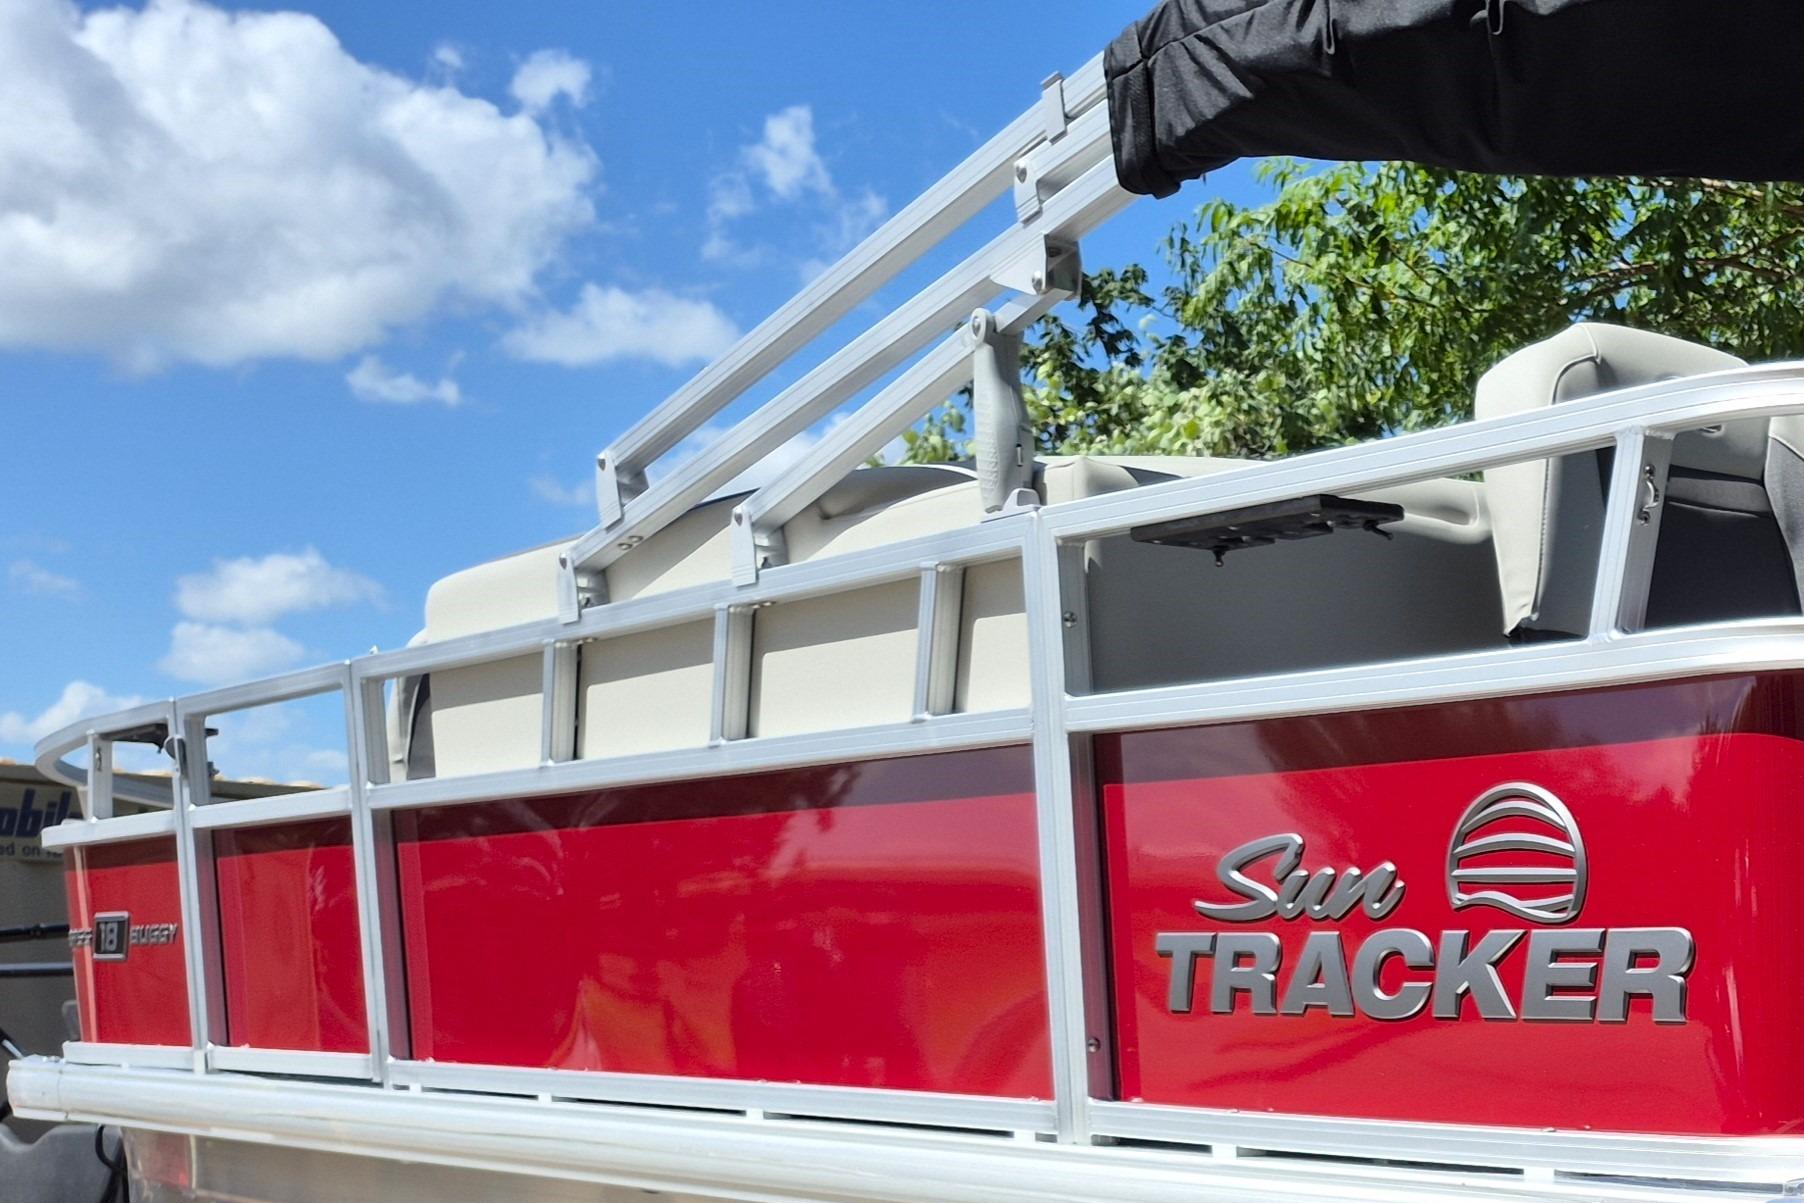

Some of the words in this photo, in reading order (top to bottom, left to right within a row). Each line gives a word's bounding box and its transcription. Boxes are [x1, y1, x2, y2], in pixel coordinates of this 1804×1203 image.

[1193, 832, 1407, 921] Sun
[100, 922, 119, 951] 18
[1154, 926, 1696, 1024] TRACKER
